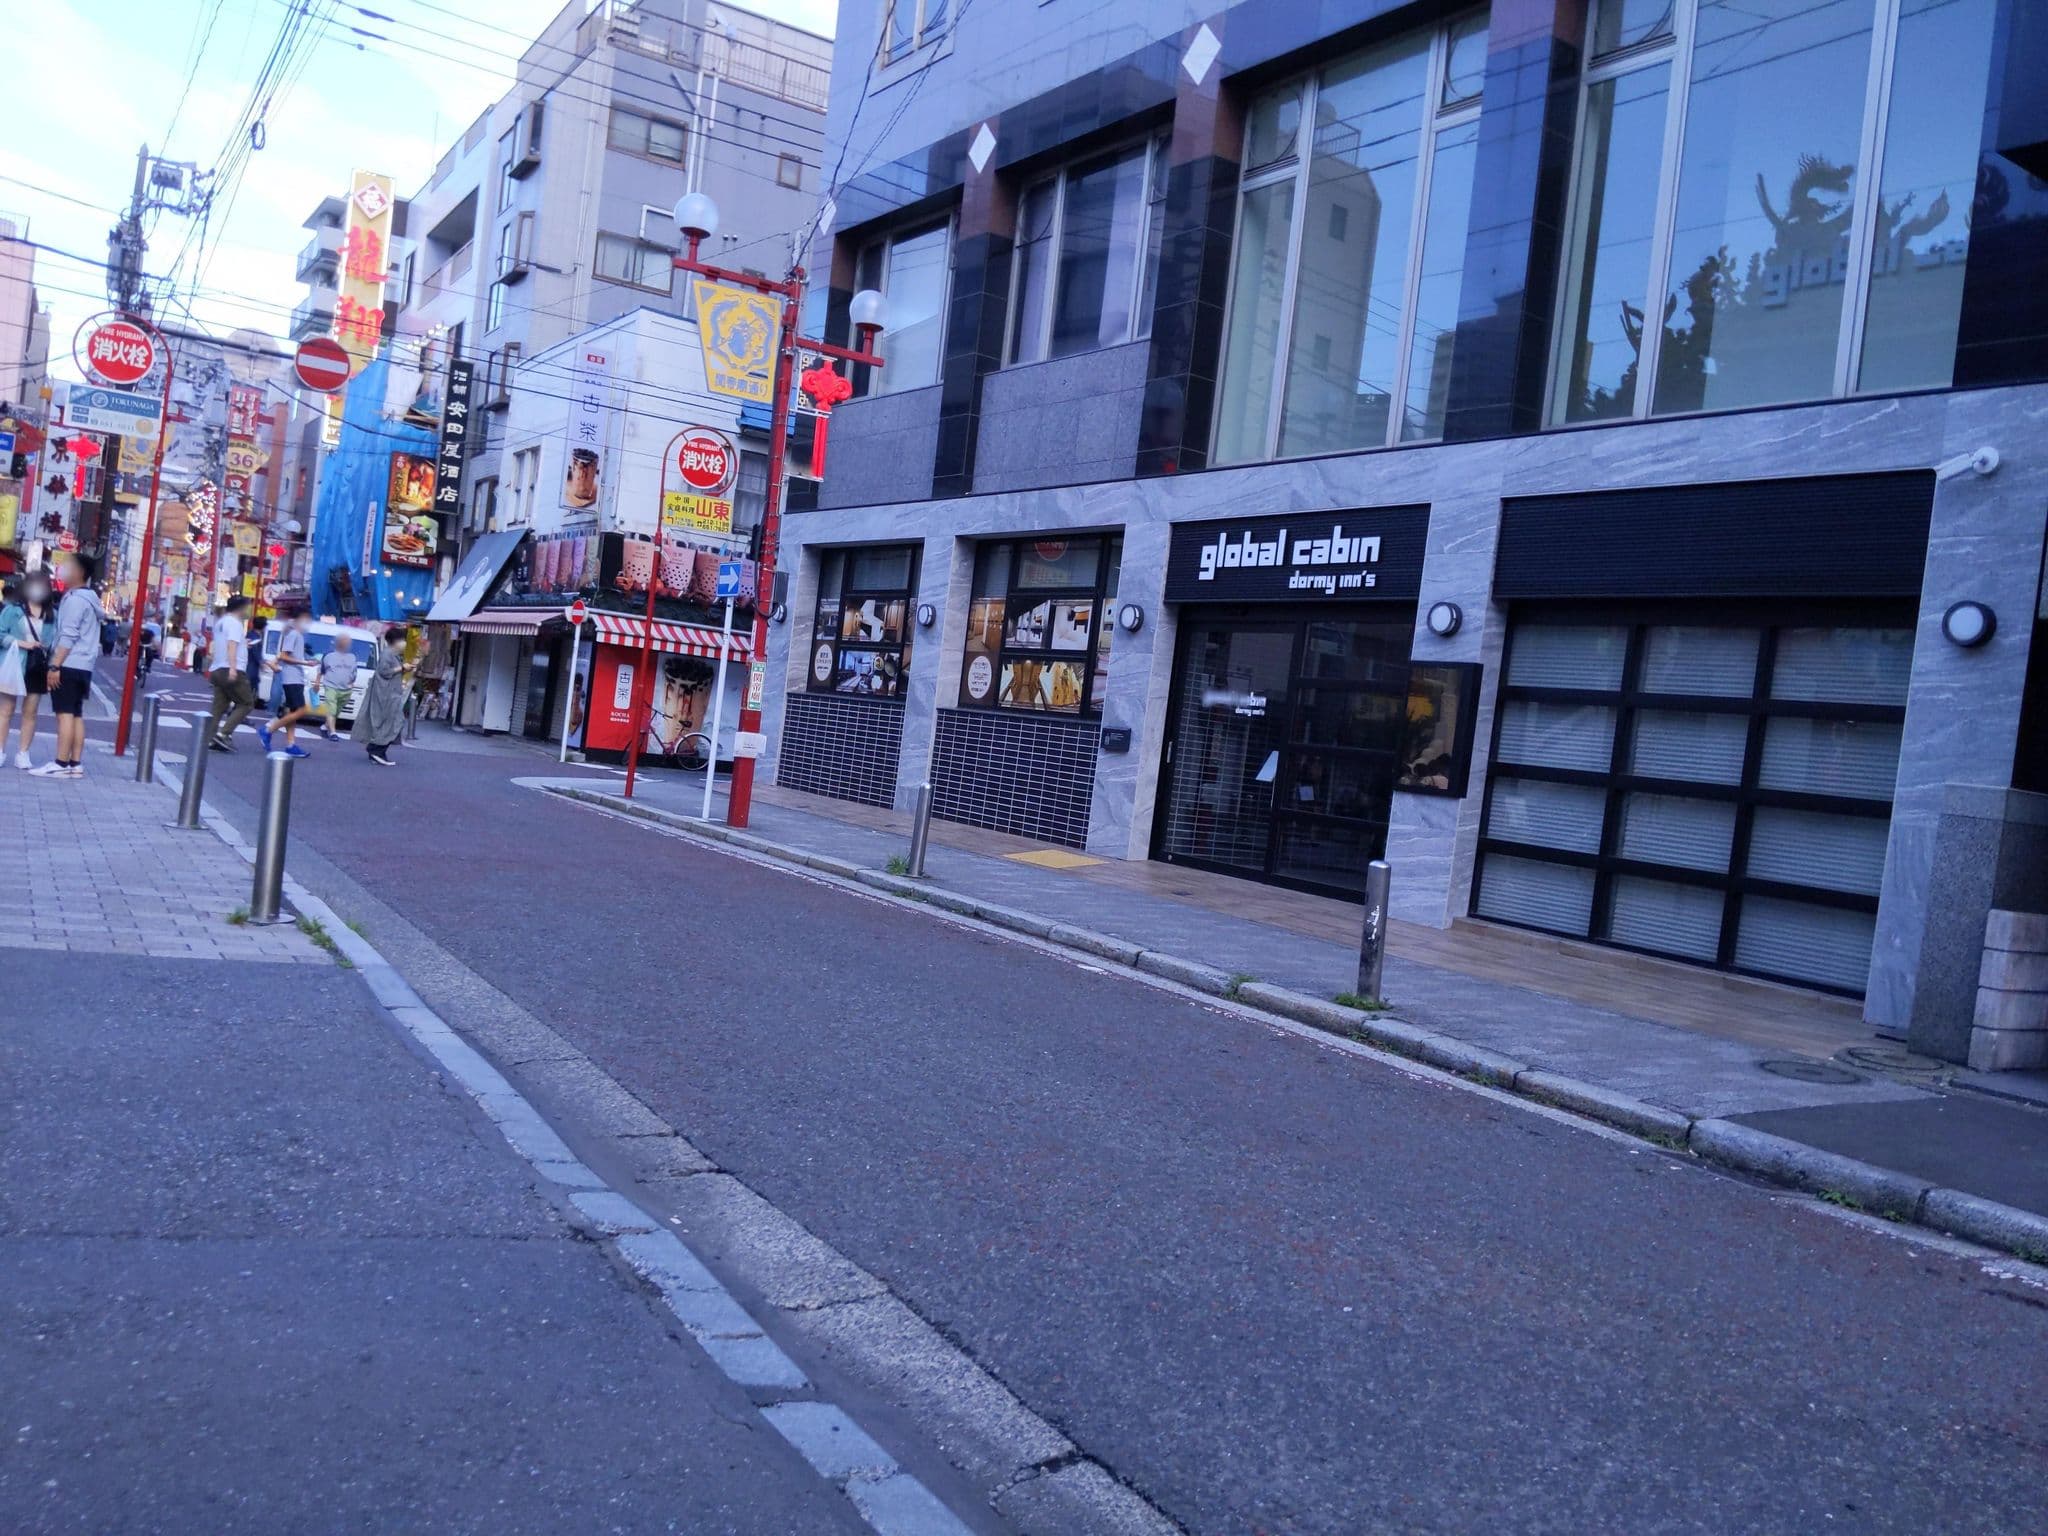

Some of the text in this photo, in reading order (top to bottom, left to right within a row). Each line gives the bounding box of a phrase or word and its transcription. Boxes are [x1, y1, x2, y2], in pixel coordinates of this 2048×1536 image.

[100, 327, 145, 342] FIRE HYDRANT
[93, 336, 149, 369] 消火栓
[111, 397, 155, 410] TOKUNAGA
[579, 393, 600, 442] 古茶
[229, 452, 254, 468] 36
[682, 449, 724, 475] 消火栓
[696, 499, 731, 521] 山東
[1198, 525, 1381, 581] global cabin
[1288, 571, 1376, 595] dormy inn's
